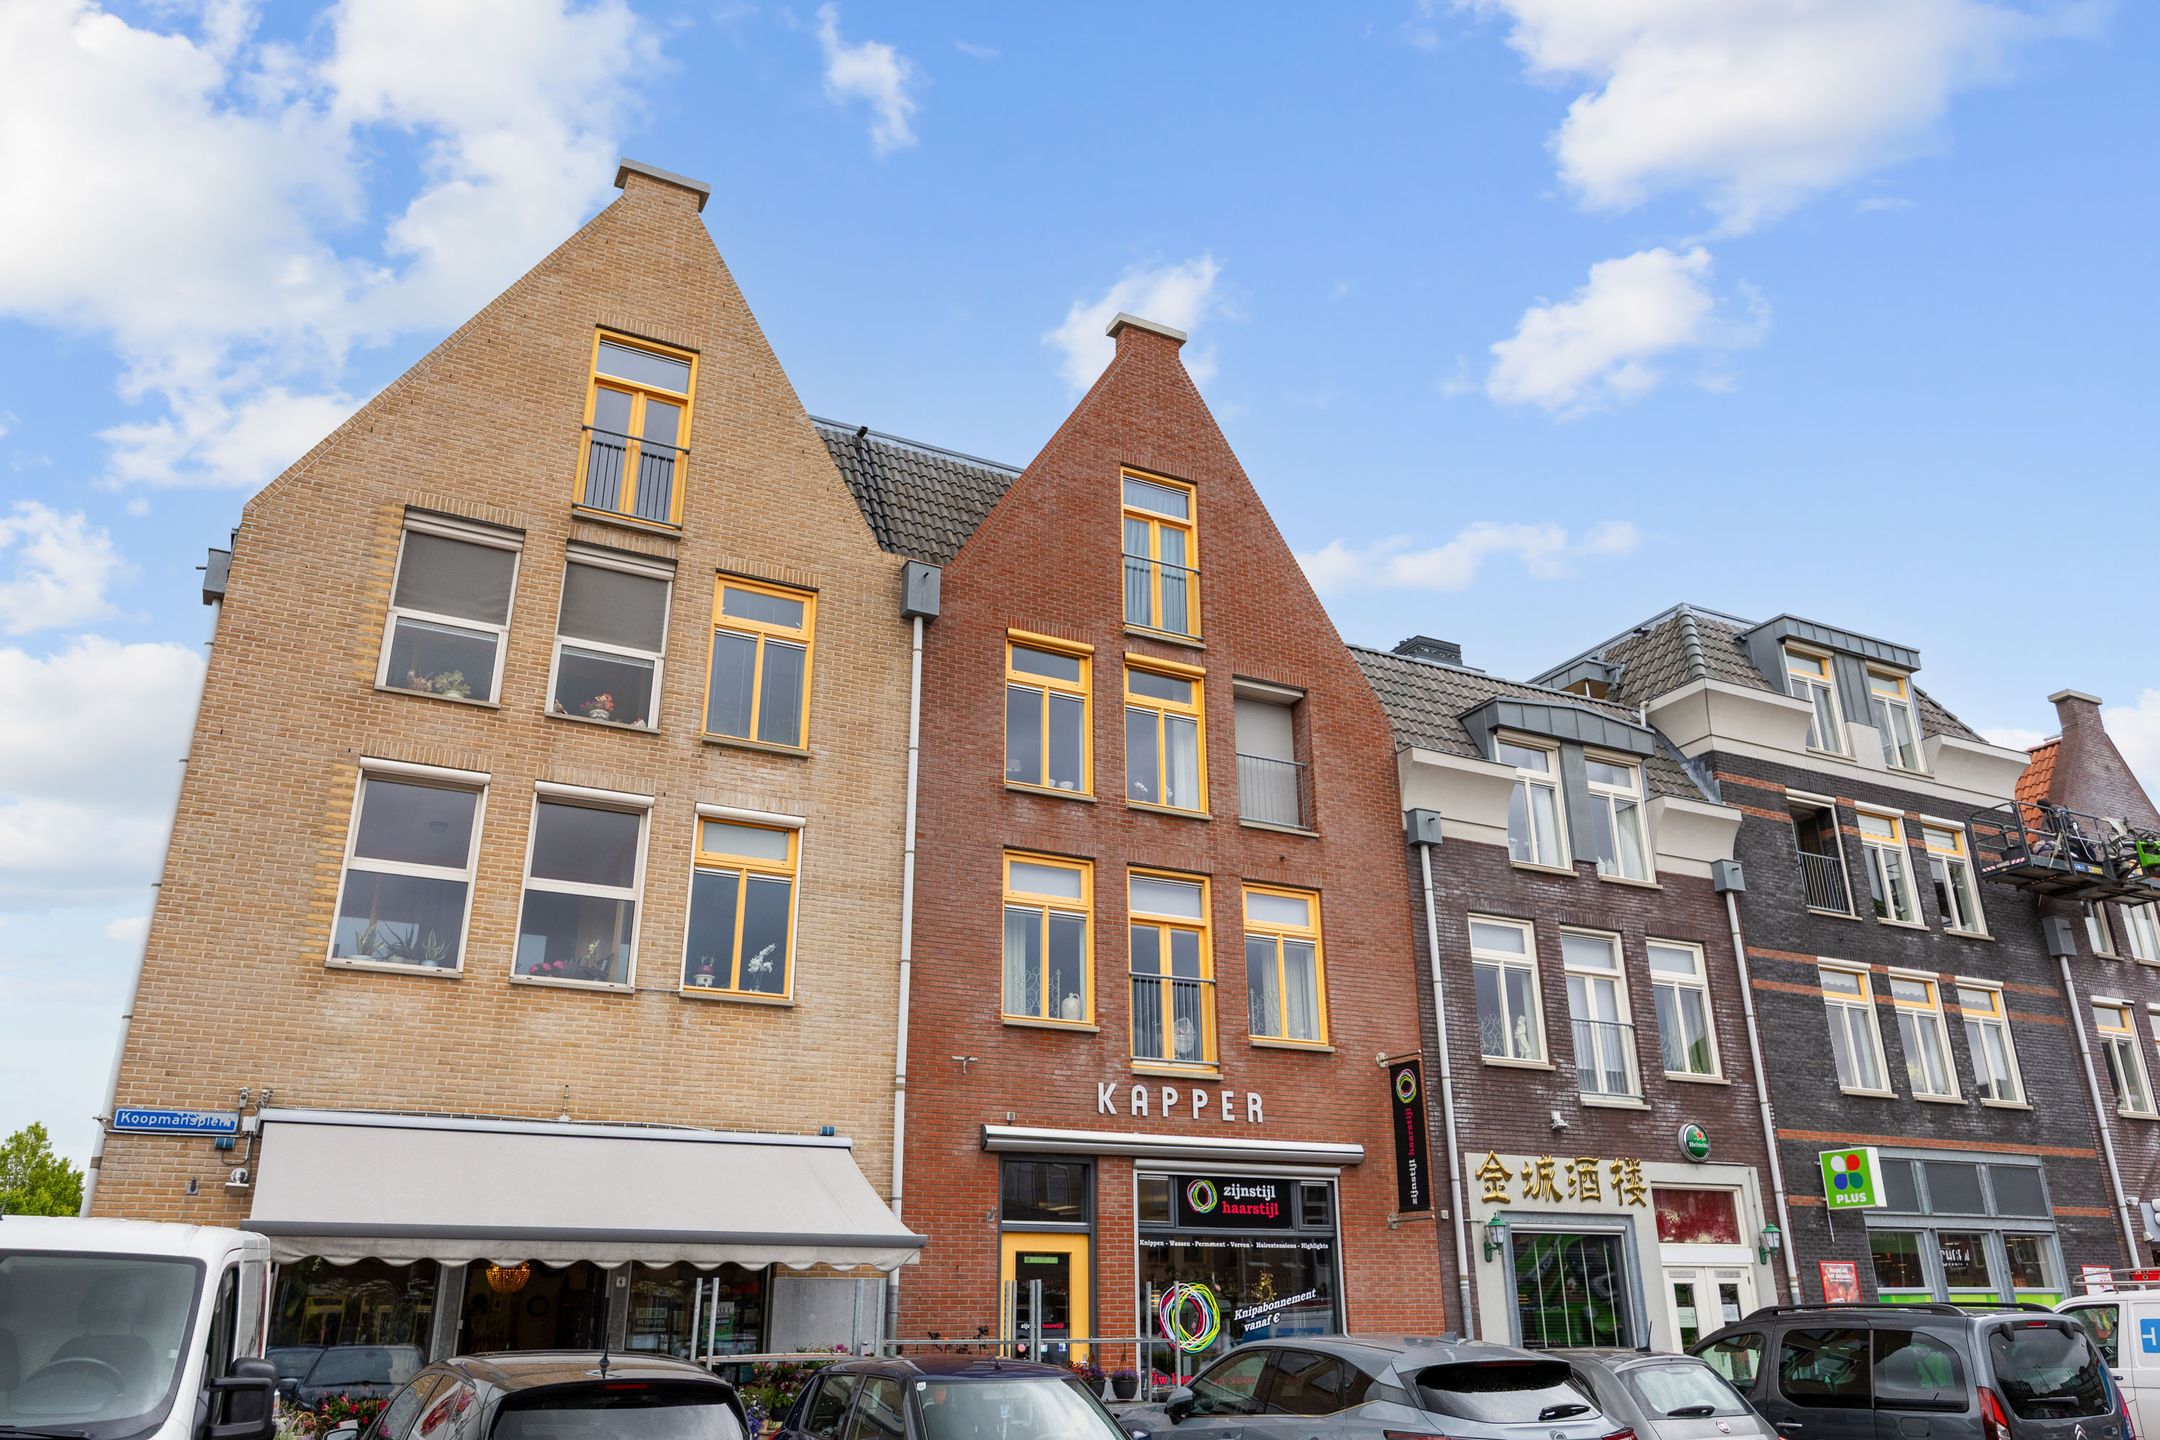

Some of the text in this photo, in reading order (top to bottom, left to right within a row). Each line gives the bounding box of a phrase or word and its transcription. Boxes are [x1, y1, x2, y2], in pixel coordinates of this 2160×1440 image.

[1097, 1082, 1264, 1123] KAPPER
[1404, 1107, 1419, 1205] zijnstijl haarstijl
[1223, 1183, 1276, 1201] zijnstijl
[1836, 1192, 1867, 1204] PLUS
[1222, 1201, 1279, 1218] haarstijl
[1140, 1239, 1164, 1247] Knippen
[1234, 1288, 1316, 1320] Knipabonnement
[1244, 1314, 1272, 1332] vanaf
